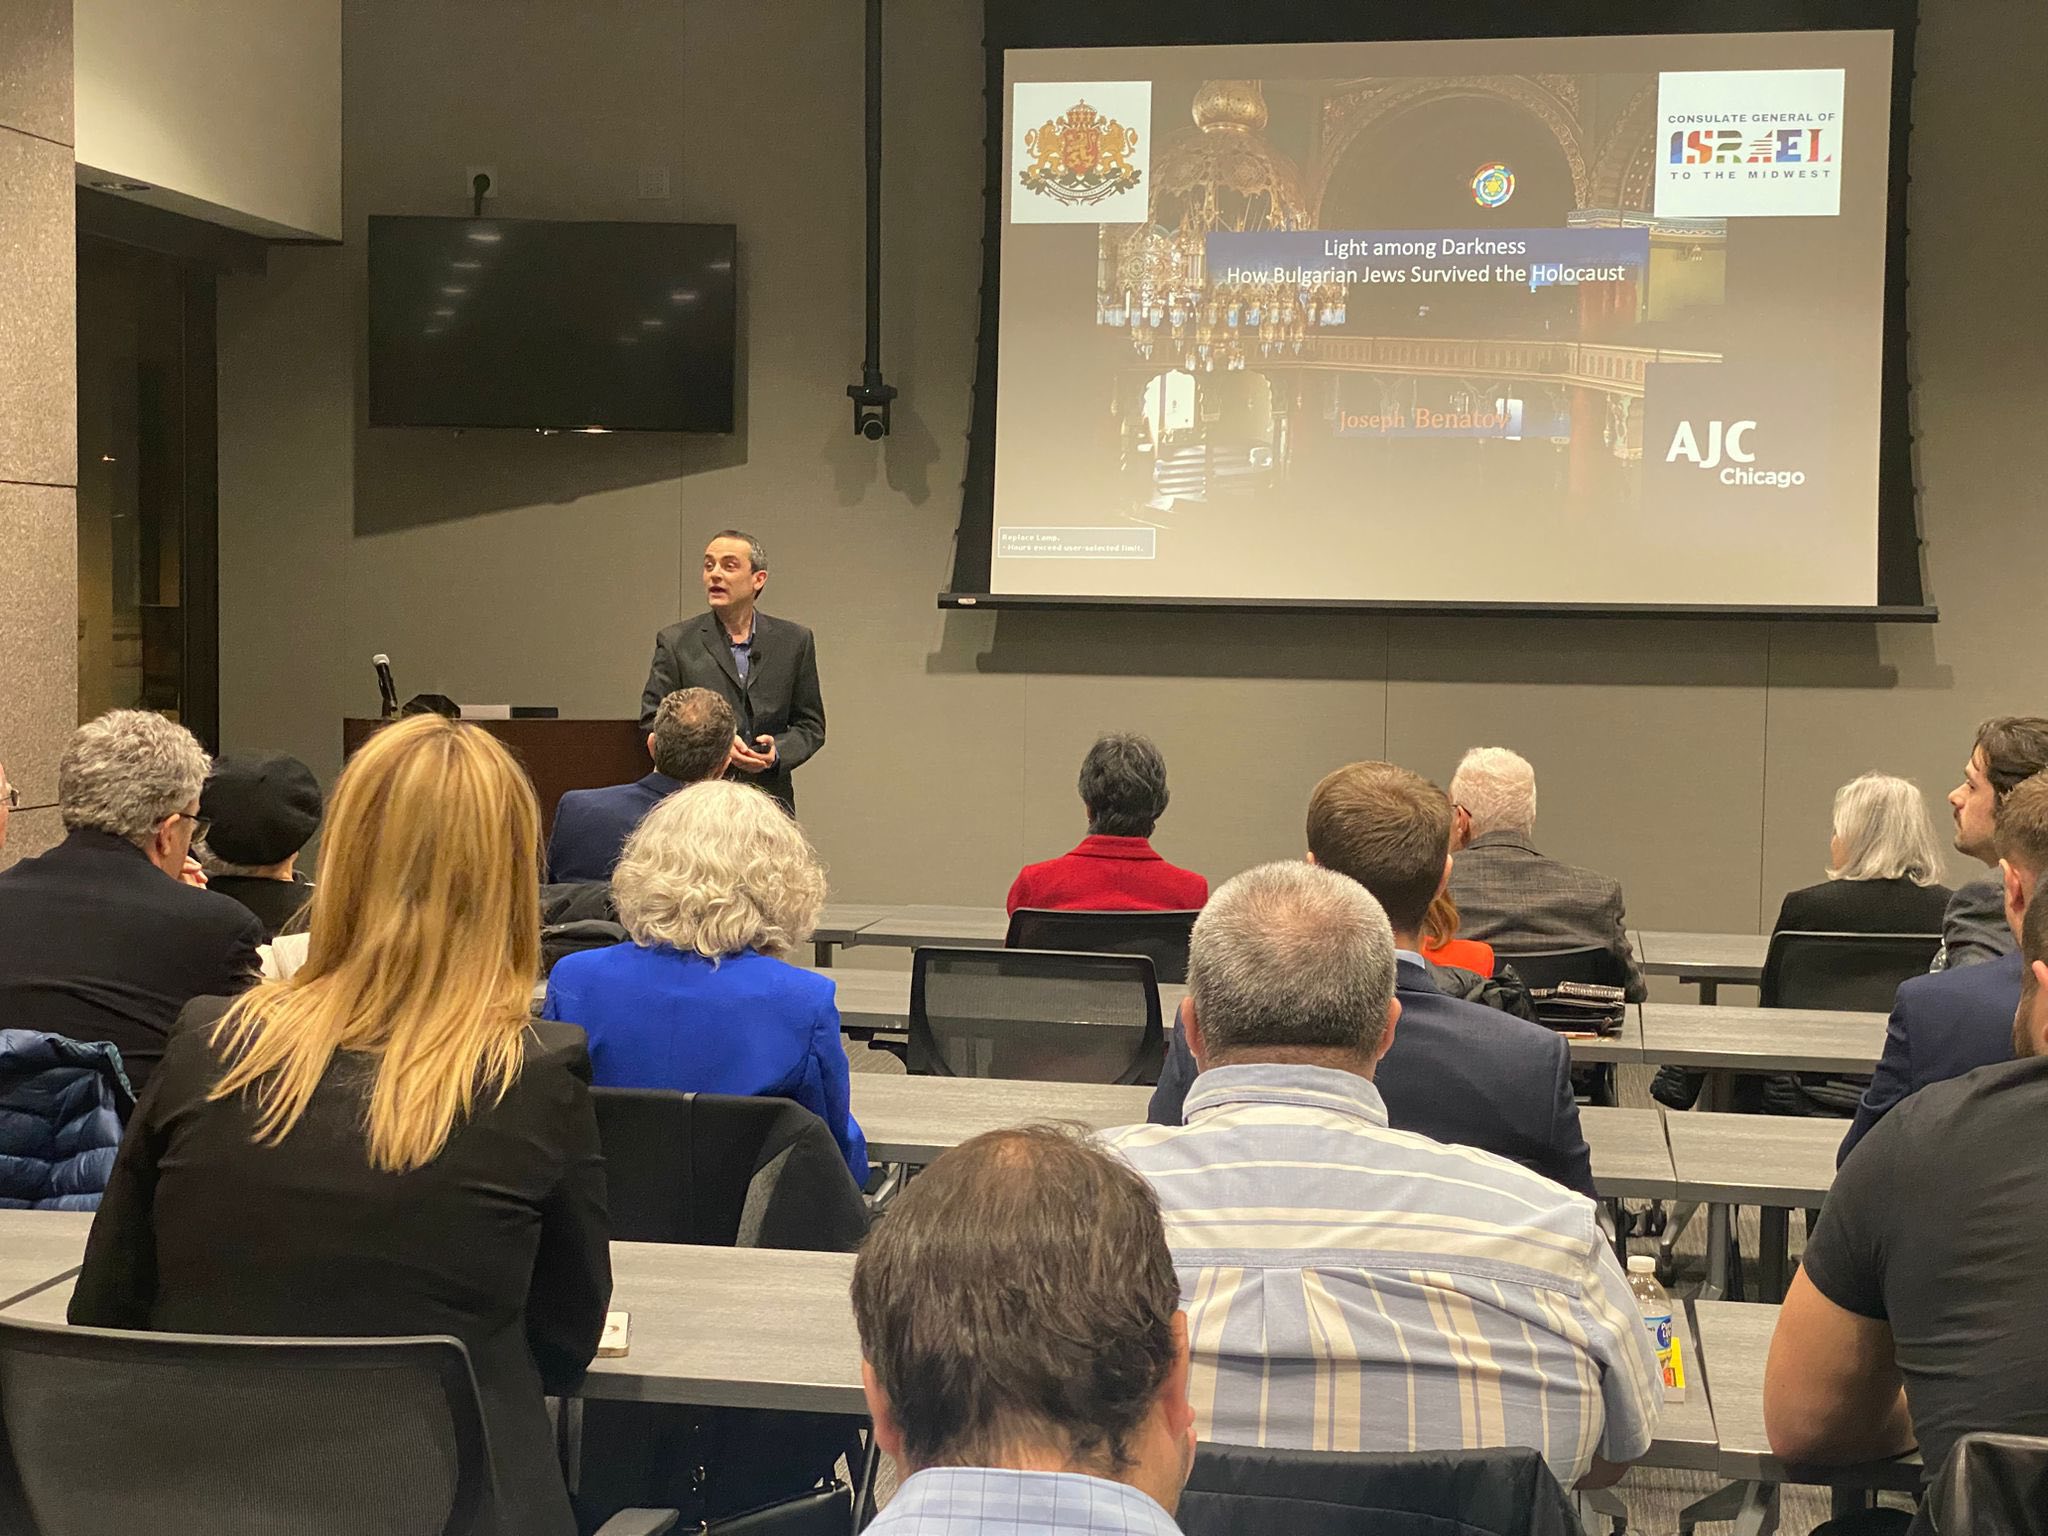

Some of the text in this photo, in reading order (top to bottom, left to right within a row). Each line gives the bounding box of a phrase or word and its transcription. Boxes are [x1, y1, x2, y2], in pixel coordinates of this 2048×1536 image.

[1668, 112, 1836, 123] CONSULATE GENERAL OF
[1670, 128, 1832, 164] ISRAEL
[1671, 170, 1831, 180] TO THE MIDWEST
[1324, 238, 1526, 260] Light among Darkness
[1227, 264, 1626, 287] How Bulgarian Jews Survived the Holocaust
[1340, 408, 1510, 432] Joseph Benatov
[1665, 420, 1757, 469] AJC
[1720, 467, 1805, 488] Chicago
[1002, 534, 1034, 542] Replace
[1121, 544, 1144, 552] limit.
